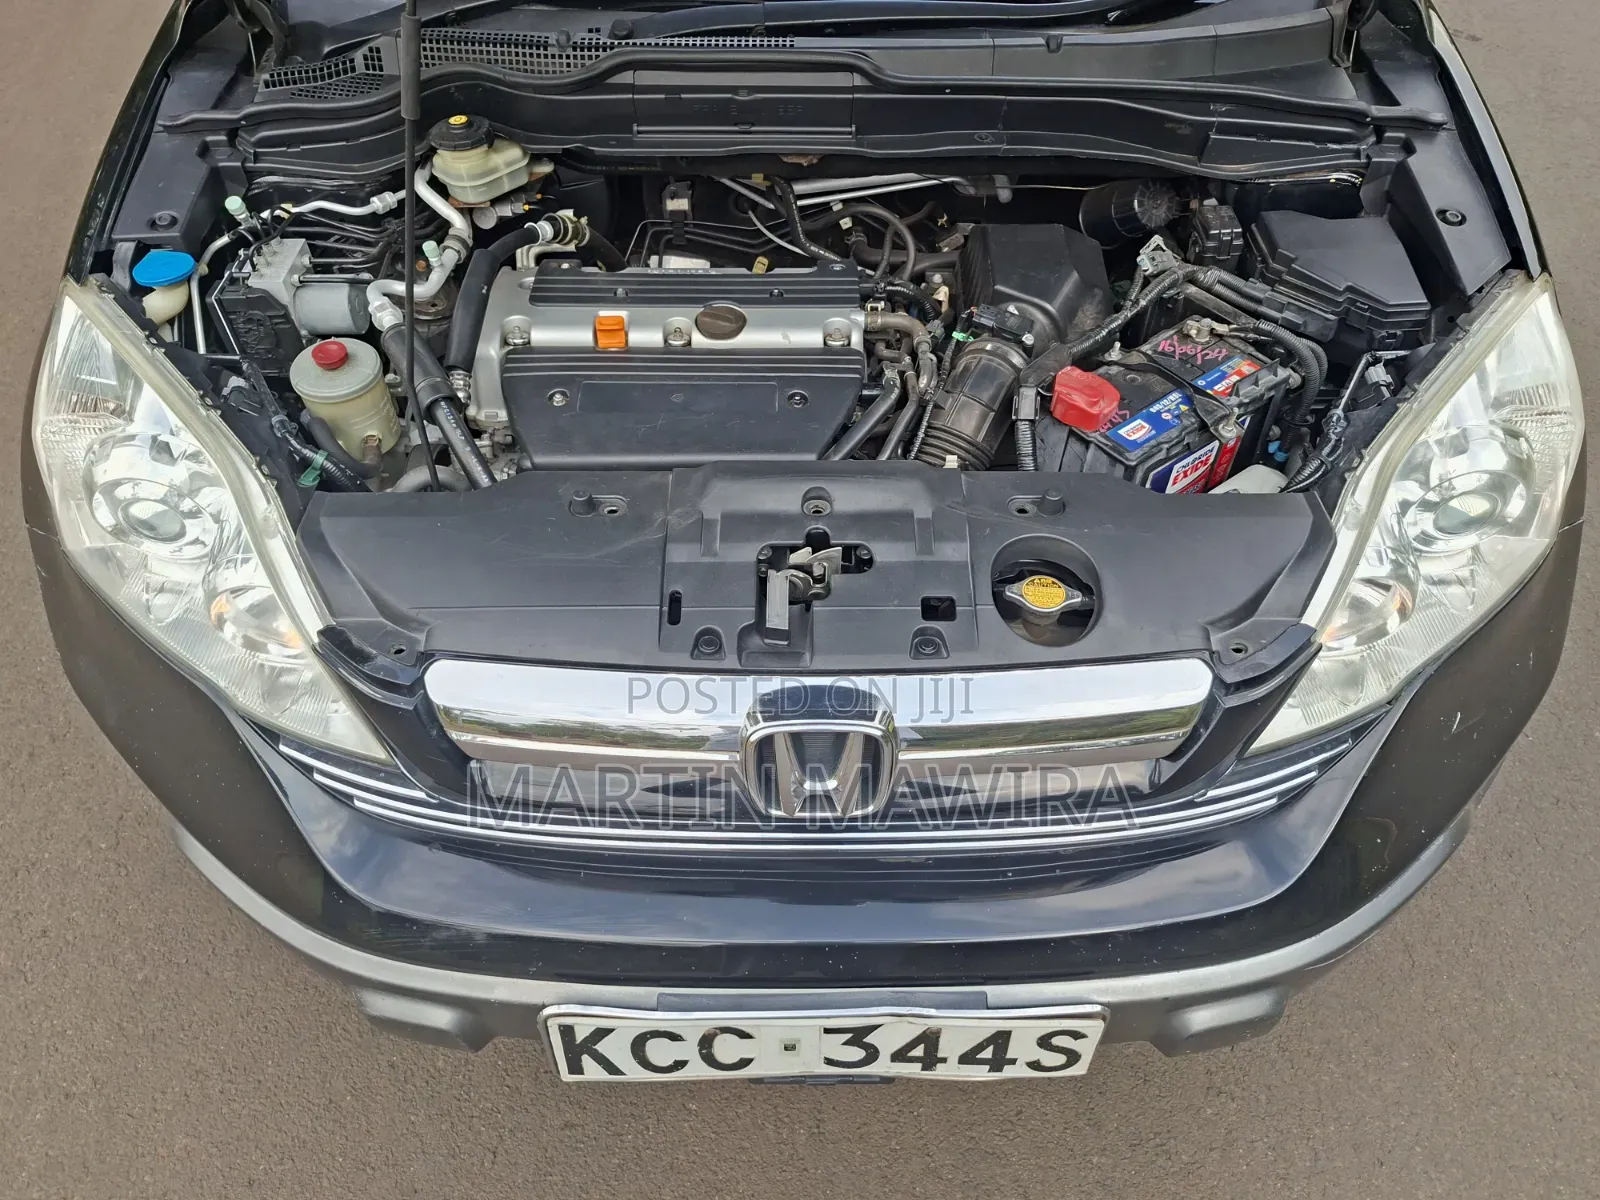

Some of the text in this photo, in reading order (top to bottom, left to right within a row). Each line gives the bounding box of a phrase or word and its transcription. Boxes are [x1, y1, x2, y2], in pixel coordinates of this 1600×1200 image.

[1158, 335, 1228, 364] 16/06/24
[1171, 453, 1213, 487] EXIDE
[1176, 445, 1215, 474] CHLORIDE
[558, 1023, 1090, 1076] KCC 344S
